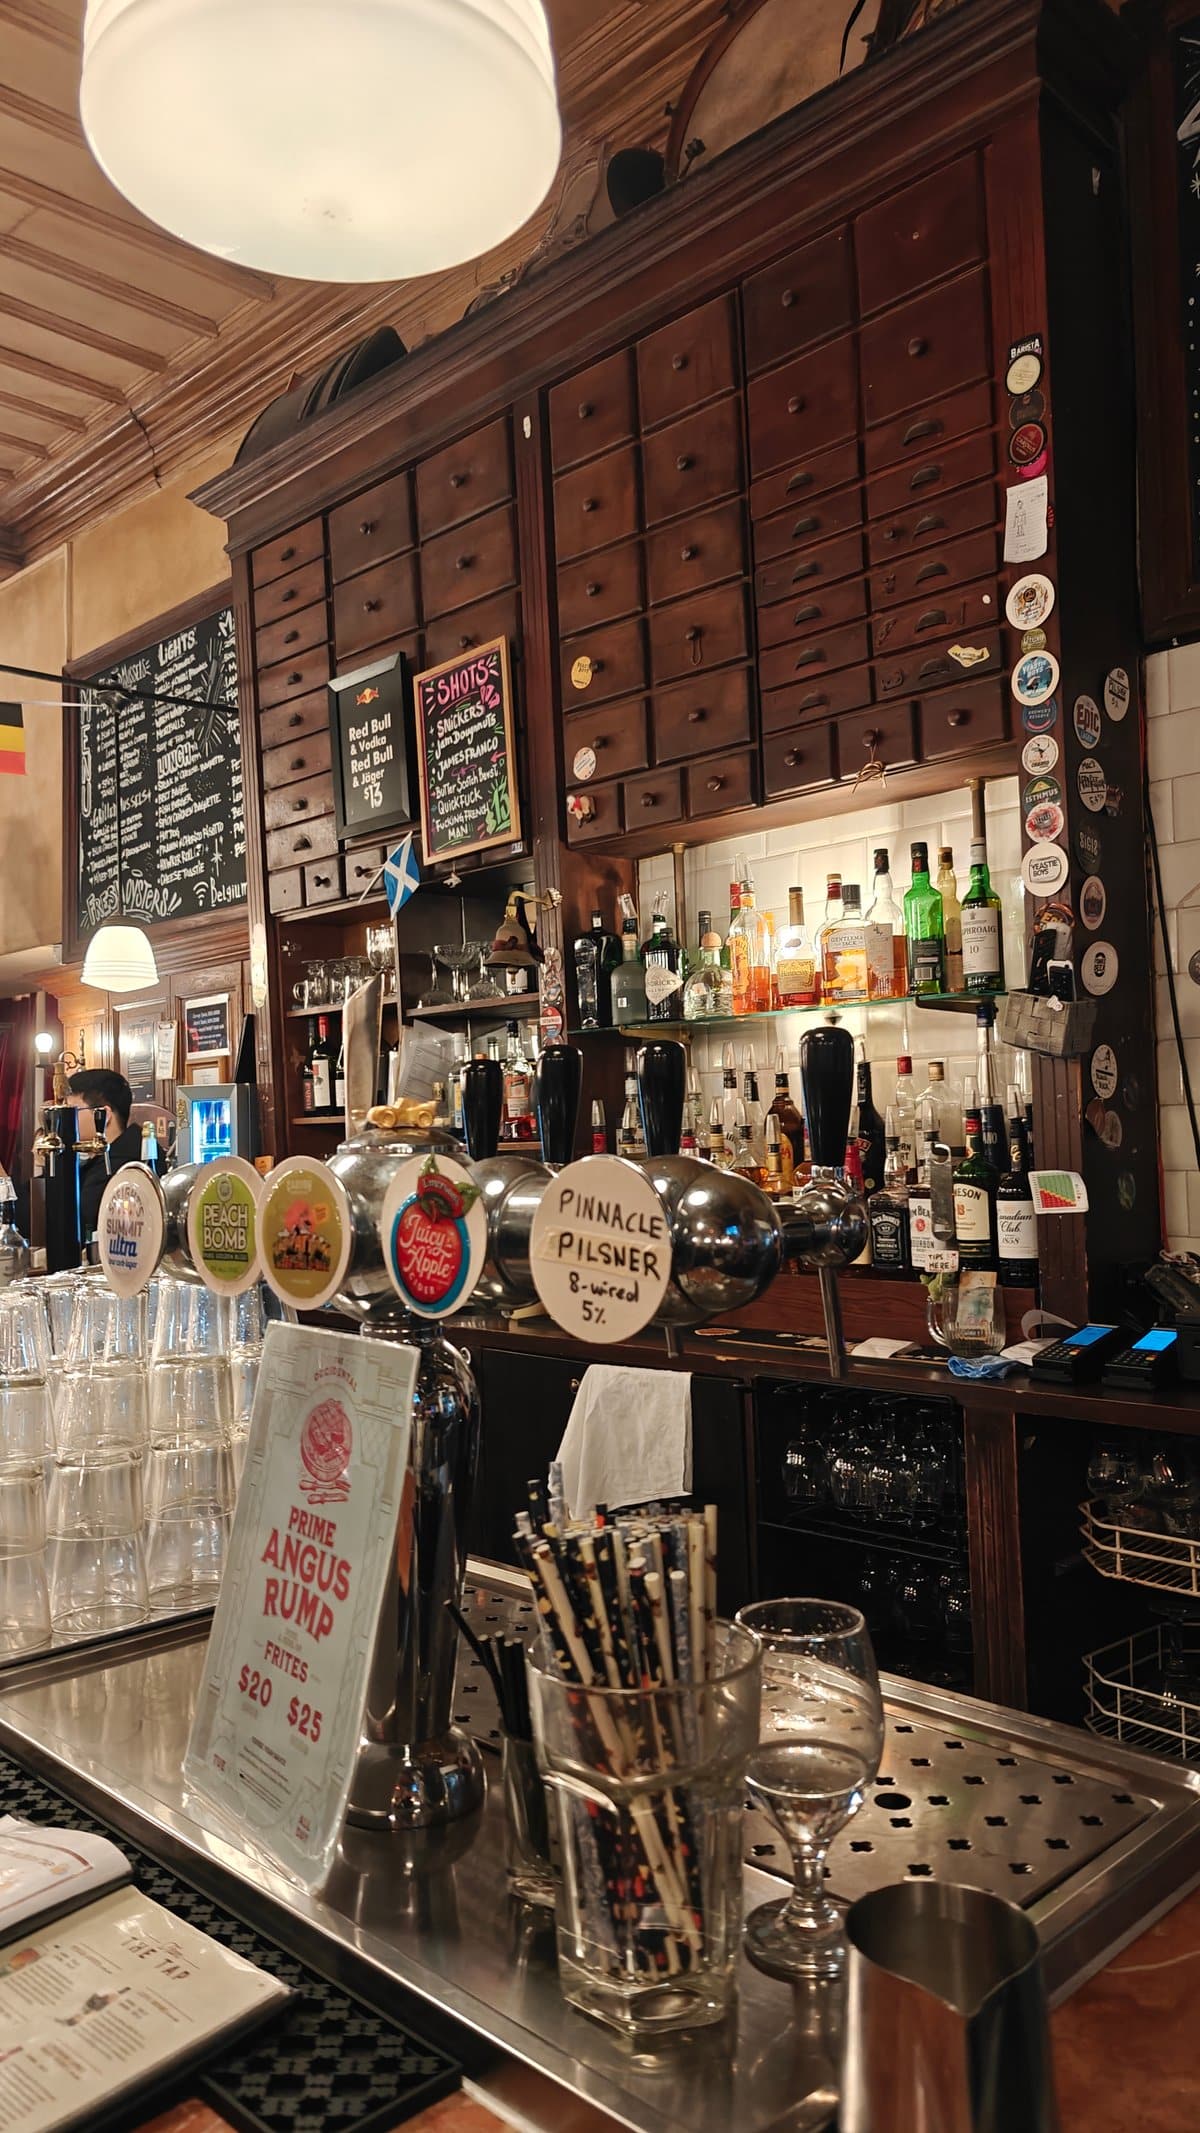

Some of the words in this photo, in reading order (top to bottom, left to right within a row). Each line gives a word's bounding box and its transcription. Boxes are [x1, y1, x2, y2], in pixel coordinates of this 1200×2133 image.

[1010, 338, 1041, 359] BARISTA
[157, 629, 196, 668] LIGHTS
[437, 660, 490, 705] SHOTS
[348, 720, 369, 742] Red
[371, 712, 392, 734] Bull
[1077, 703, 1100, 733] Epic
[80, 688, 93, 818] MENU
[350, 743, 358, 756] &
[359, 734, 387, 753] Vodka
[157, 742, 193, 780] LUNCH
[350, 753, 371, 775] Red
[373, 744, 394, 766] Bull
[437, 753, 465, 781] JAMES
[464, 736, 499, 765] FRANCO
[352, 775, 360, 789] &
[361, 768, 385, 786] Jäger
[193, 793, 222, 814] BAGUETTE
[363, 780, 383, 809] $13
[460, 787, 483, 808] FUCK
[1025, 788, 1059, 804] ISTHMUS
[202, 820, 224, 839] RISOTTO
[447, 822, 469, 841] MAN
[1031, 859, 1058, 872] YEASTIE
[1032, 868, 1049, 877] BOYS
[160, 870, 182, 887] CHEESE
[830, 935, 864, 944] GENTLEMA
[962, 924, 998, 936] PHROAIG
[969, 944, 980, 955] 10
[203, 1203, 249, 1228] PEACH
[559, 1189, 665, 1240] PINNACLE
[106, 1218, 145, 1238] SUMMIT
[203, 1226, 248, 1251] BOMB
[400, 1214, 453, 1259] Juicy
[109, 1233, 138, 1257] ultra
[558, 1231, 661, 1281] PILSNER
[928, 1253, 945, 1262] TIPS
[403, 1245, 456, 1280] Apple
[928, 1261, 951, 1270] HERE
[408, 1272, 436, 1295] CIDER
[568, 1271, 640, 1303] 8-wired
[581, 1300, 608, 1325] 5%
[288, 1505, 337, 1548] PRIME
[260, 1527, 352, 1602] ANGUS
[262, 1577, 334, 1643] RUMP
[263, 1640, 309, 1684] FRITES
[237, 1663, 273, 1708] $20
[286, 1695, 323, 1743] $25
[120, 1935, 158, 1960] THE
[154, 1957, 191, 1981] TAP
